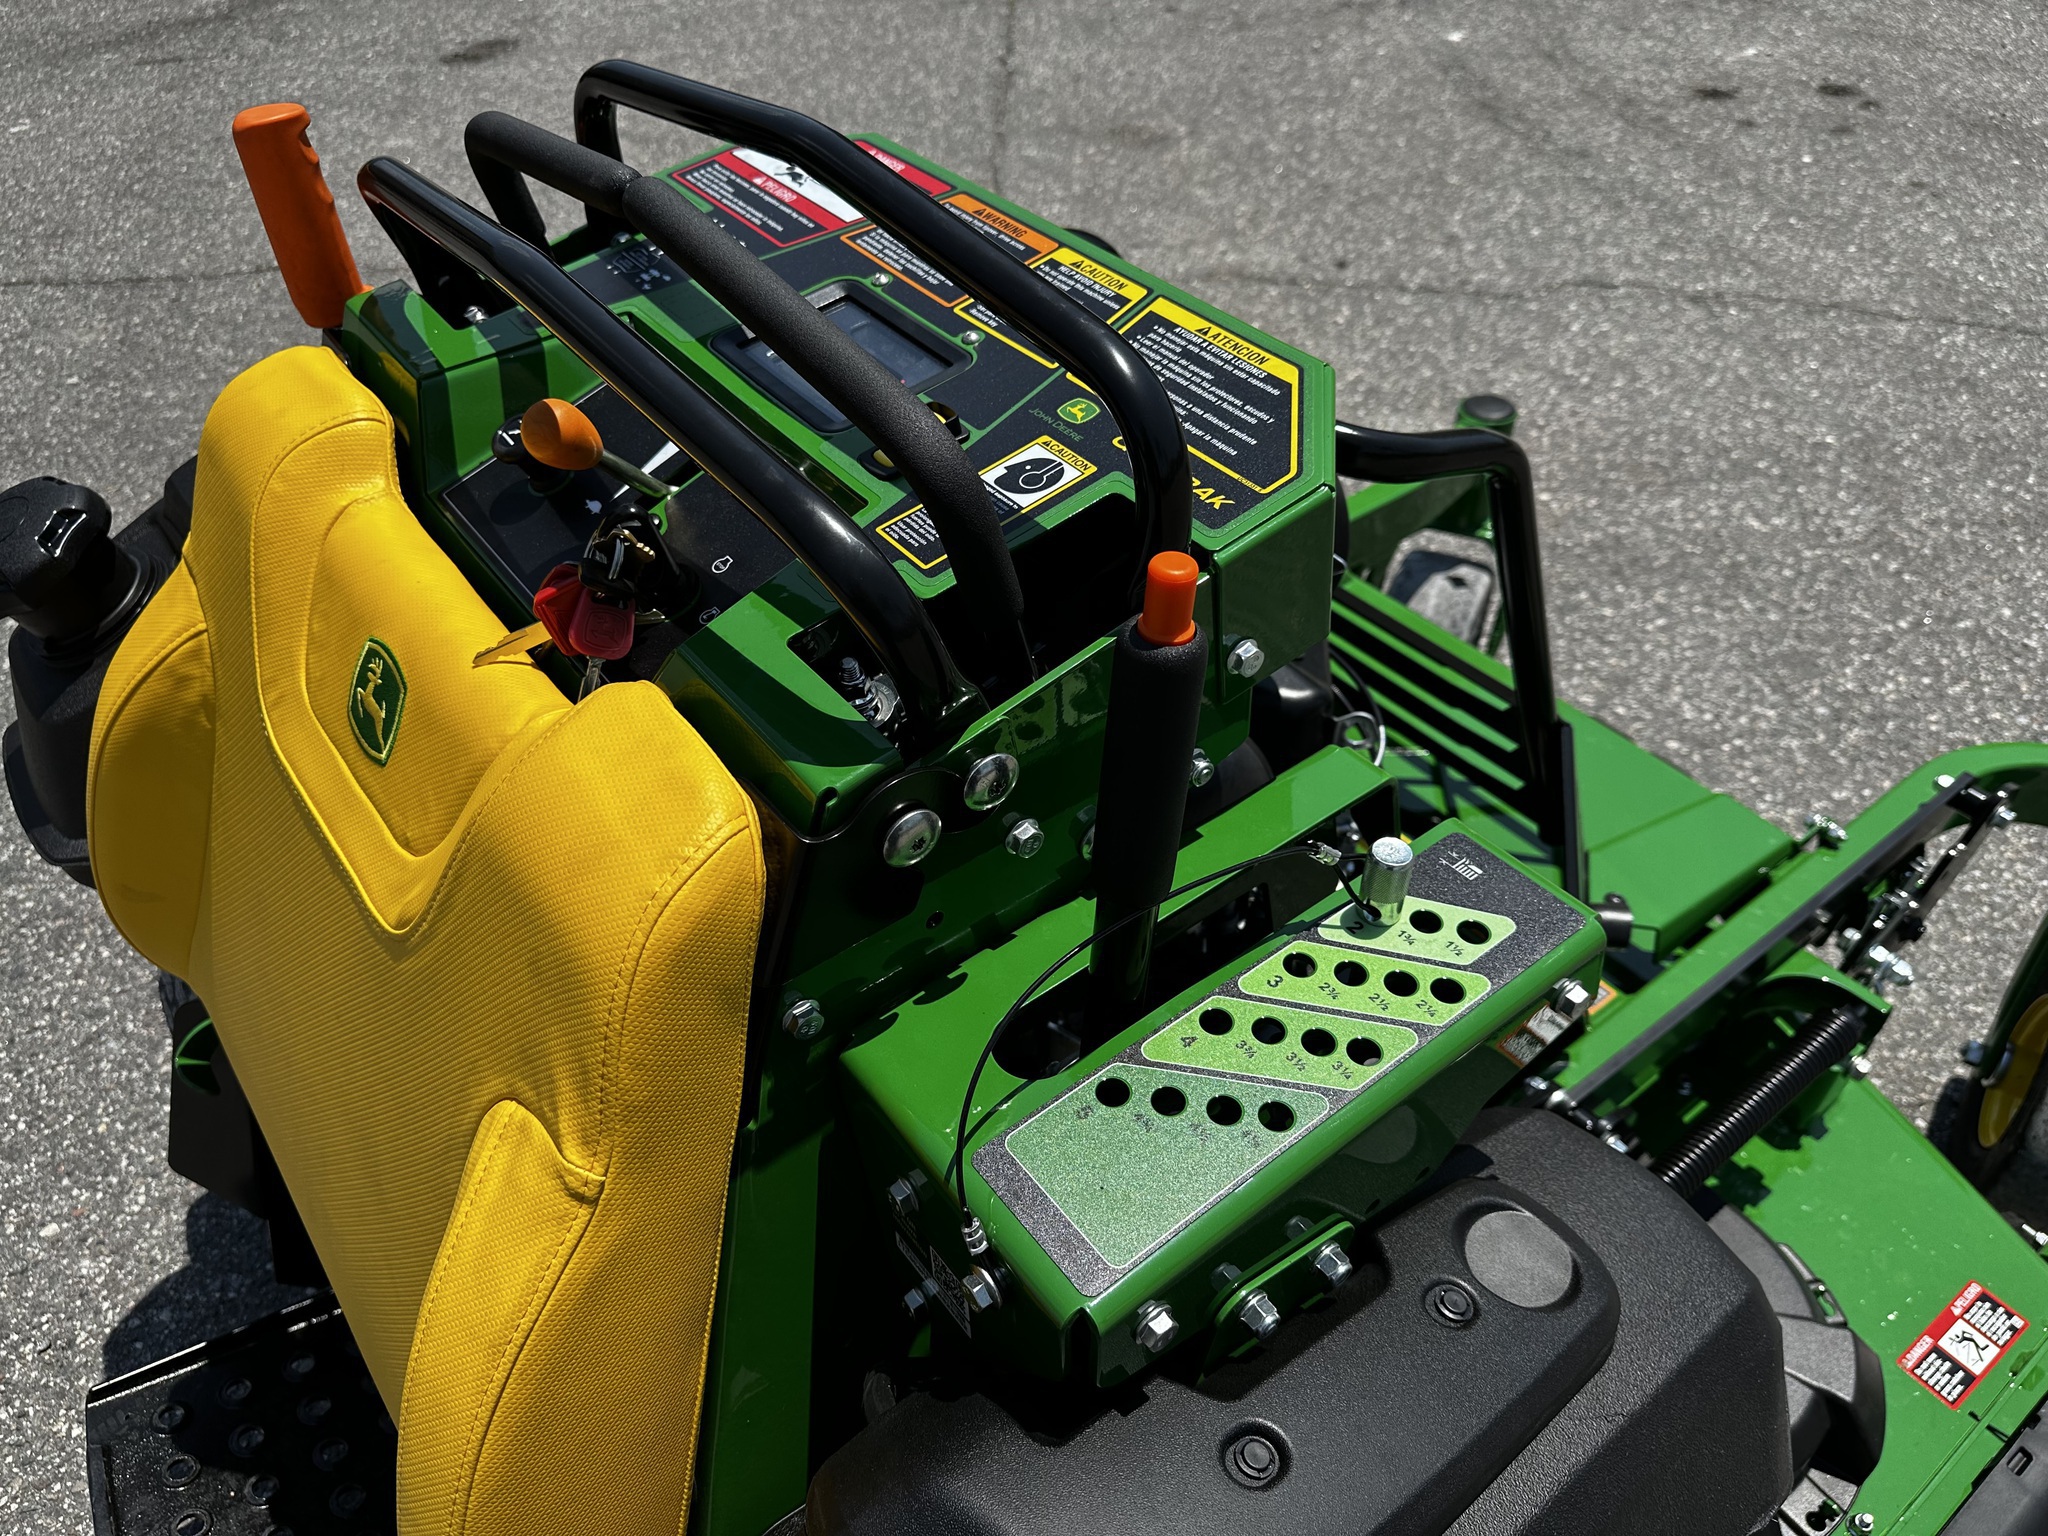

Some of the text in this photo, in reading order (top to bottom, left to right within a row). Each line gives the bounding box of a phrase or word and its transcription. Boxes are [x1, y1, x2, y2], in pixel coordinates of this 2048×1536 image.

[762, 180, 798, 202] PELIGRO
[982, 211, 1028, 239] WARNING
[1058, 266, 1116, 297] HELP AVOID INJURY
[1079, 261, 1129, 292] CAUTION
[1139, 337, 1153, 346] Leer
[1158, 348, 1180, 360] manual
[1188, 364, 1214, 379] operador
[1147, 333, 1182, 352] para hacerlo
[1174, 327, 1203, 344] AYUDAR
[1207, 345, 1233, 360] EVITAR
[1231, 358, 1267, 378] LESIONES
[1209, 332, 1271, 365] ATENCION
[1165, 332, 1188, 346] manejar
[1187, 344, 1200, 353] esta
[1232, 369, 1249, 379] estar
[1248, 377, 1280, 395] capacitado
[1139, 347, 1162, 361] manejar
[1200, 380, 1211, 388] los
[1244, 405, 1270, 420] escudos
[1161, 369, 1190, 386] seguridad
[1188, 384, 1217, 402] instalados
[1221, 402, 1257, 424] funcionando
[1028, 408, 1084, 442] JOHN DEERE
[1191, 407, 1204, 415] una
[1203, 413, 1230, 430] distancia
[1228, 428, 1257, 445] prudente
[1049, 443, 1092, 471] CAUTION
[1346, 921, 1364, 935] 2
[1266, 975, 1284, 988] 3
[1180, 1035, 1199, 1048] 4
[1907, 1335, 1935, 1364] DANGER
